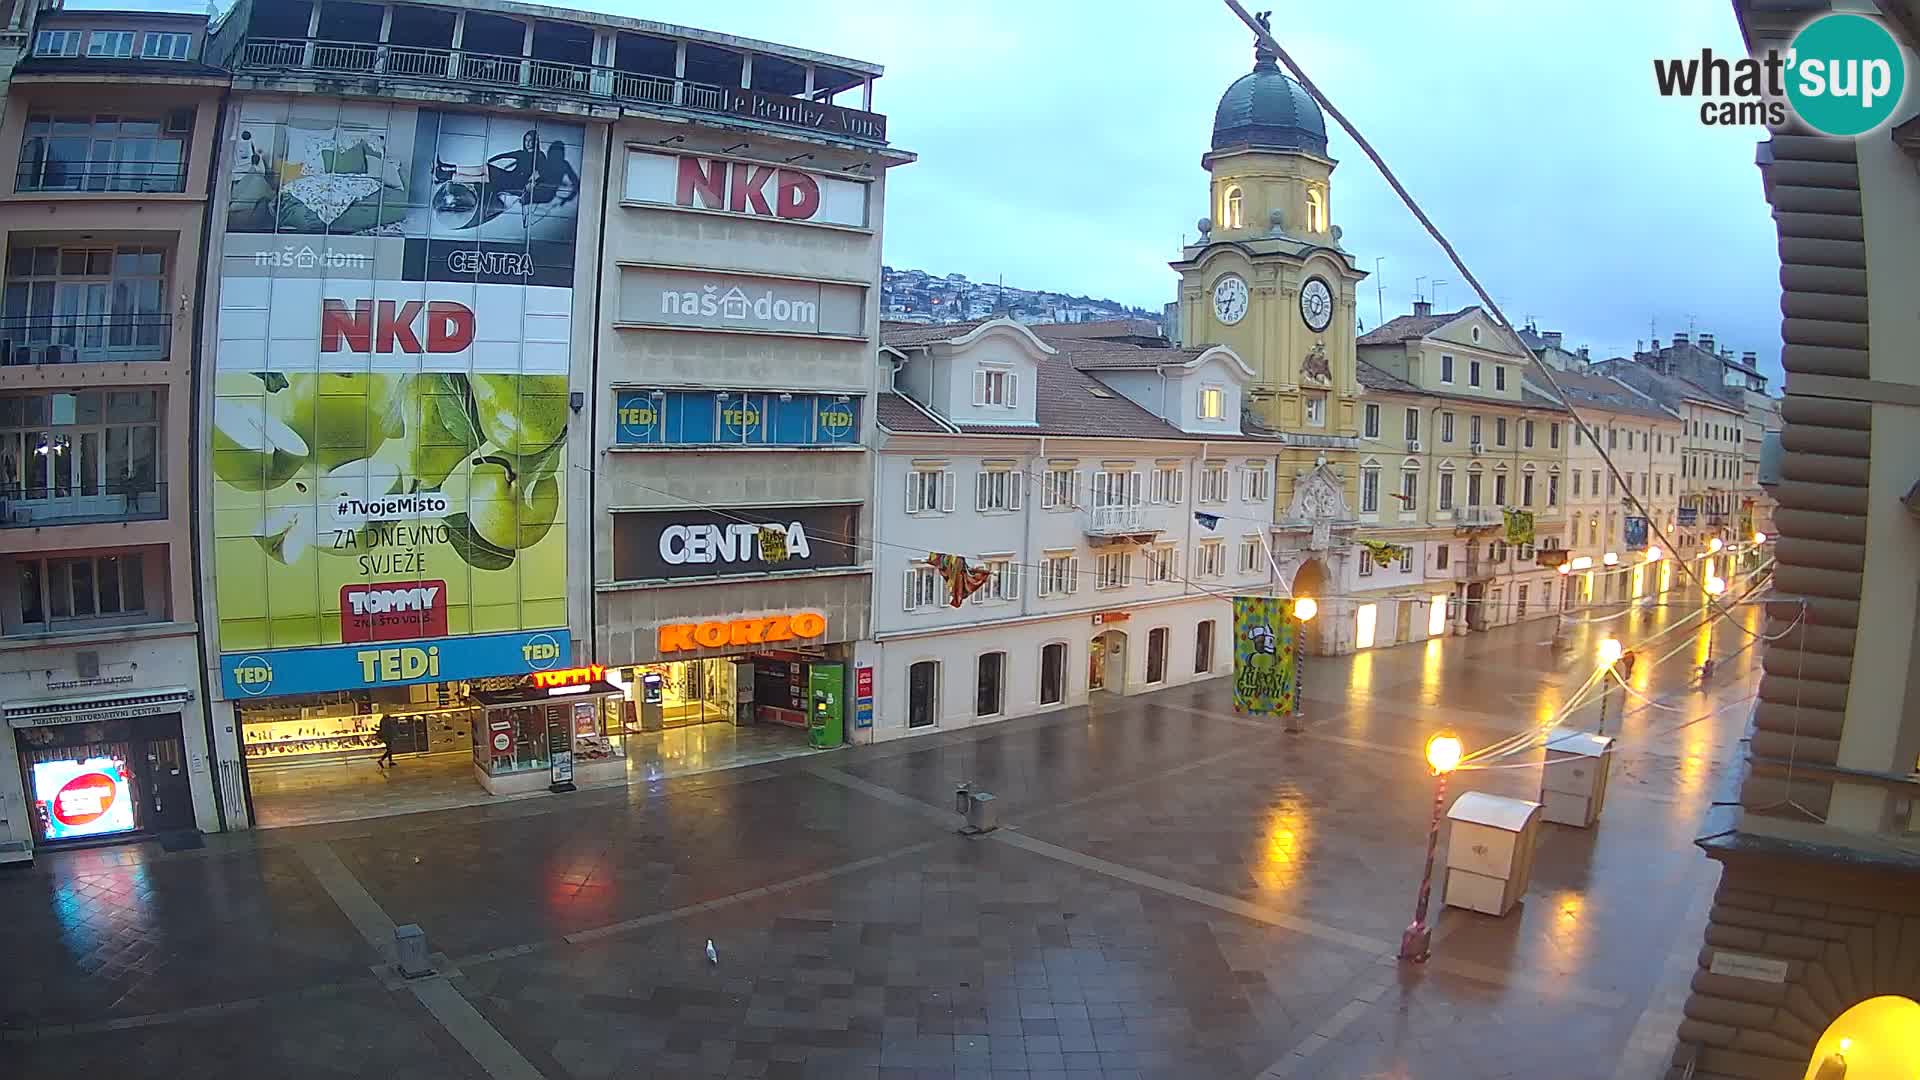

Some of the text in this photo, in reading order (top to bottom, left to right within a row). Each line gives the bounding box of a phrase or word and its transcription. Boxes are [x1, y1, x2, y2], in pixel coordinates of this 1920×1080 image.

[676, 157, 820, 220] NKD
[255, 246, 365, 269] naš dom
[447, 250, 534, 276] CENTRA
[661, 284, 816, 323] naš dom
[320, 298, 476, 354] NKD
[618, 408, 658, 426] TEDi
[723, 409, 760, 426] TEDi
[820, 411, 853, 427] TEDi
[338, 496, 445, 517] #TvojeMisto
[333, 524, 450, 549] ZA DNEVNO
[359, 548, 426, 576] SVJEŽE
[348, 587, 439, 615] TOMMY
[657, 612, 826, 652] KORZO
[357, 646, 440, 683] TEDi
[521, 644, 560, 661] TEDi
[233, 665, 272, 685] TEDi
[533, 664, 606, 688] TOMMY
